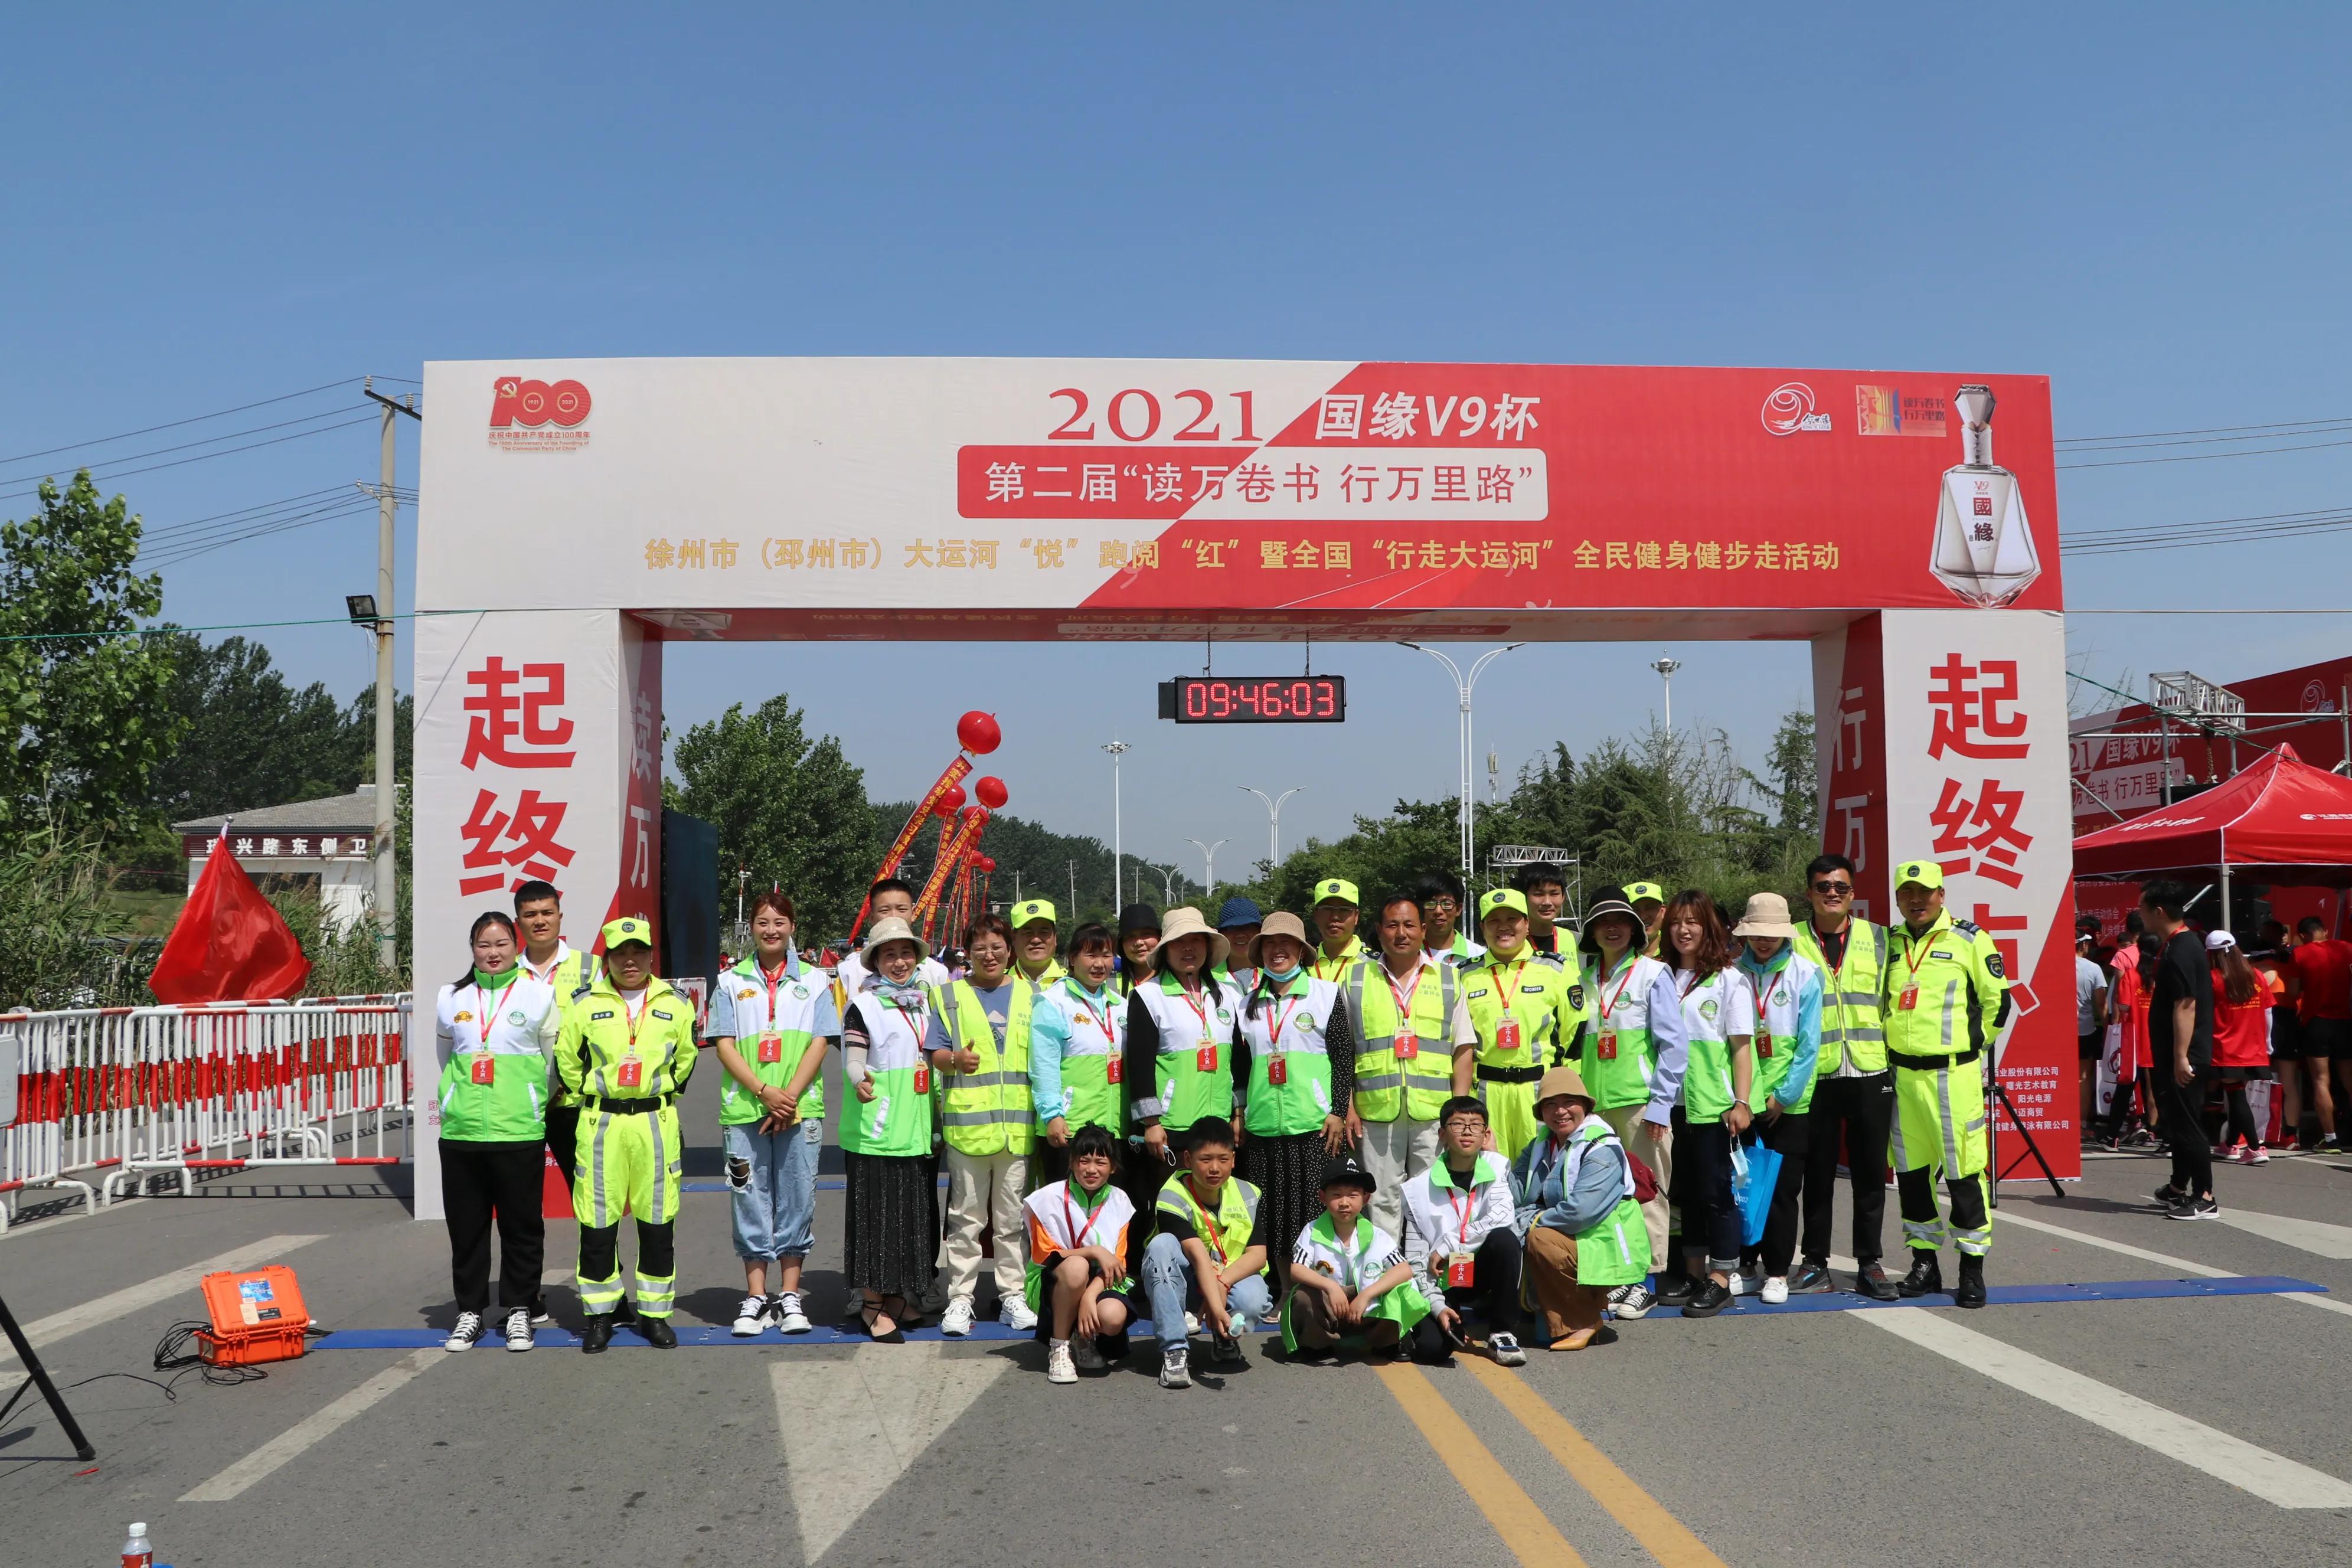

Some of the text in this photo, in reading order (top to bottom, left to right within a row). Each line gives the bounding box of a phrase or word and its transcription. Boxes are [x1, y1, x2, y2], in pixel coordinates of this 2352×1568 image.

[1904, 397, 1945, 409] 读万卷书
[1047, 390, 1541, 443] 2021 国缘V9杯
[1904, 410, 1945, 421] 行万里路
[984, 460, 1321, 503] 第二届“读万卷书
[1187, 682, 1334, 716] 09:46:03
[1982, 1067, 2059, 1077] 酒业股份有限公司
[2006, 1080, 2057, 1090] 曙光艺术教育
[2018, 1094, 2052, 1103] 阳光电源
